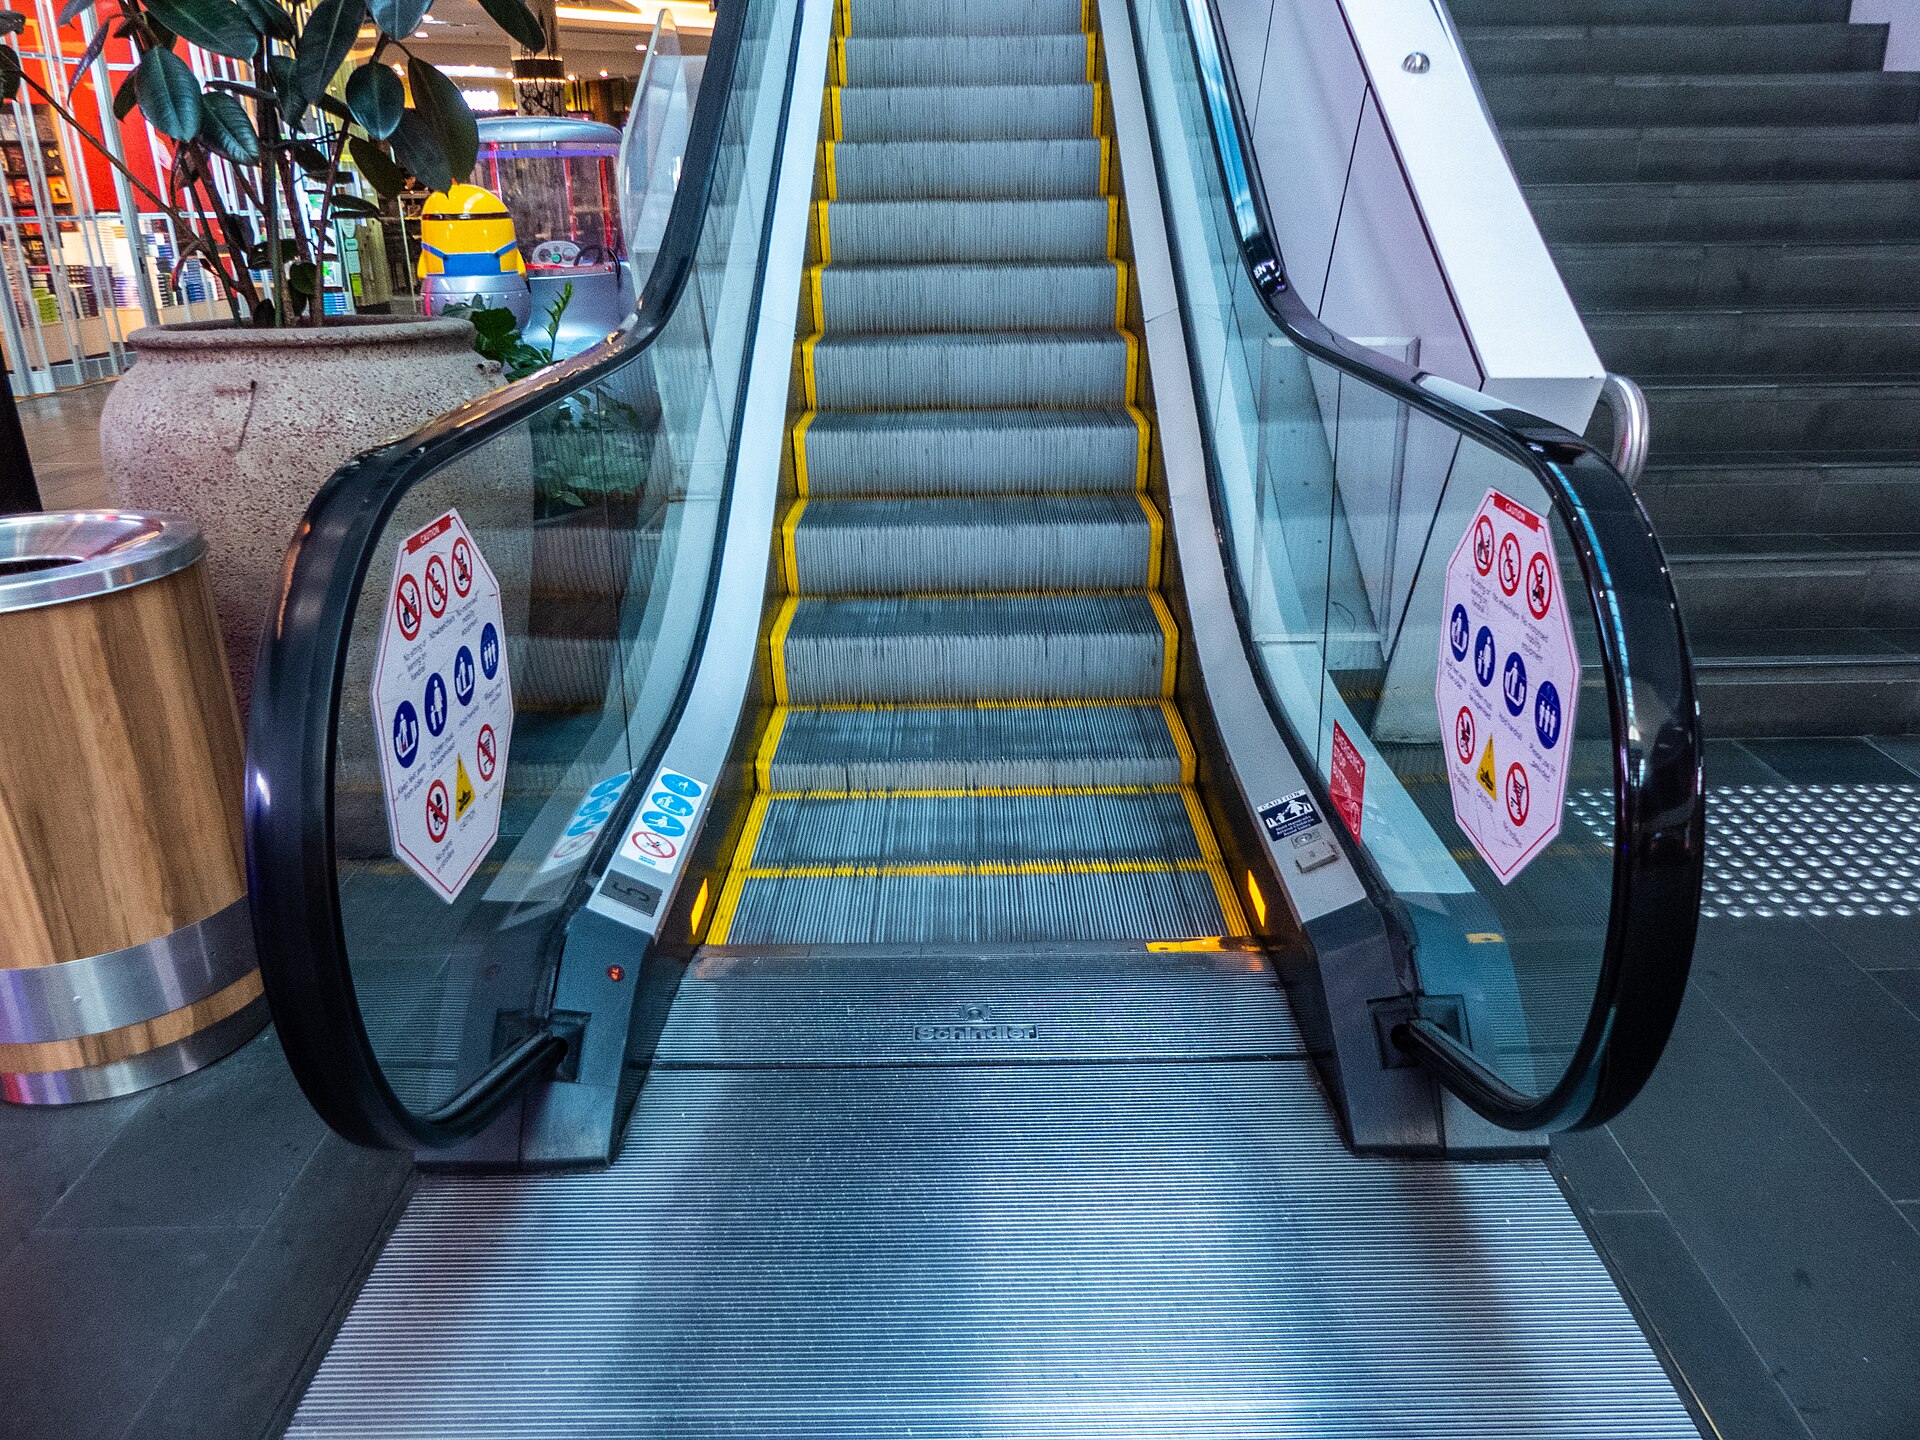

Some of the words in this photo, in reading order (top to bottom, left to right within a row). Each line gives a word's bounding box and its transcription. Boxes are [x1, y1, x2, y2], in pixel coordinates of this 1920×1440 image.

[1505, 503, 1526, 522] CAUTION
[420, 525, 440, 544] CAUTION
[1261, 791, 1301, 810] CAUTION
[915, 1026, 1035, 1040] Schindler
